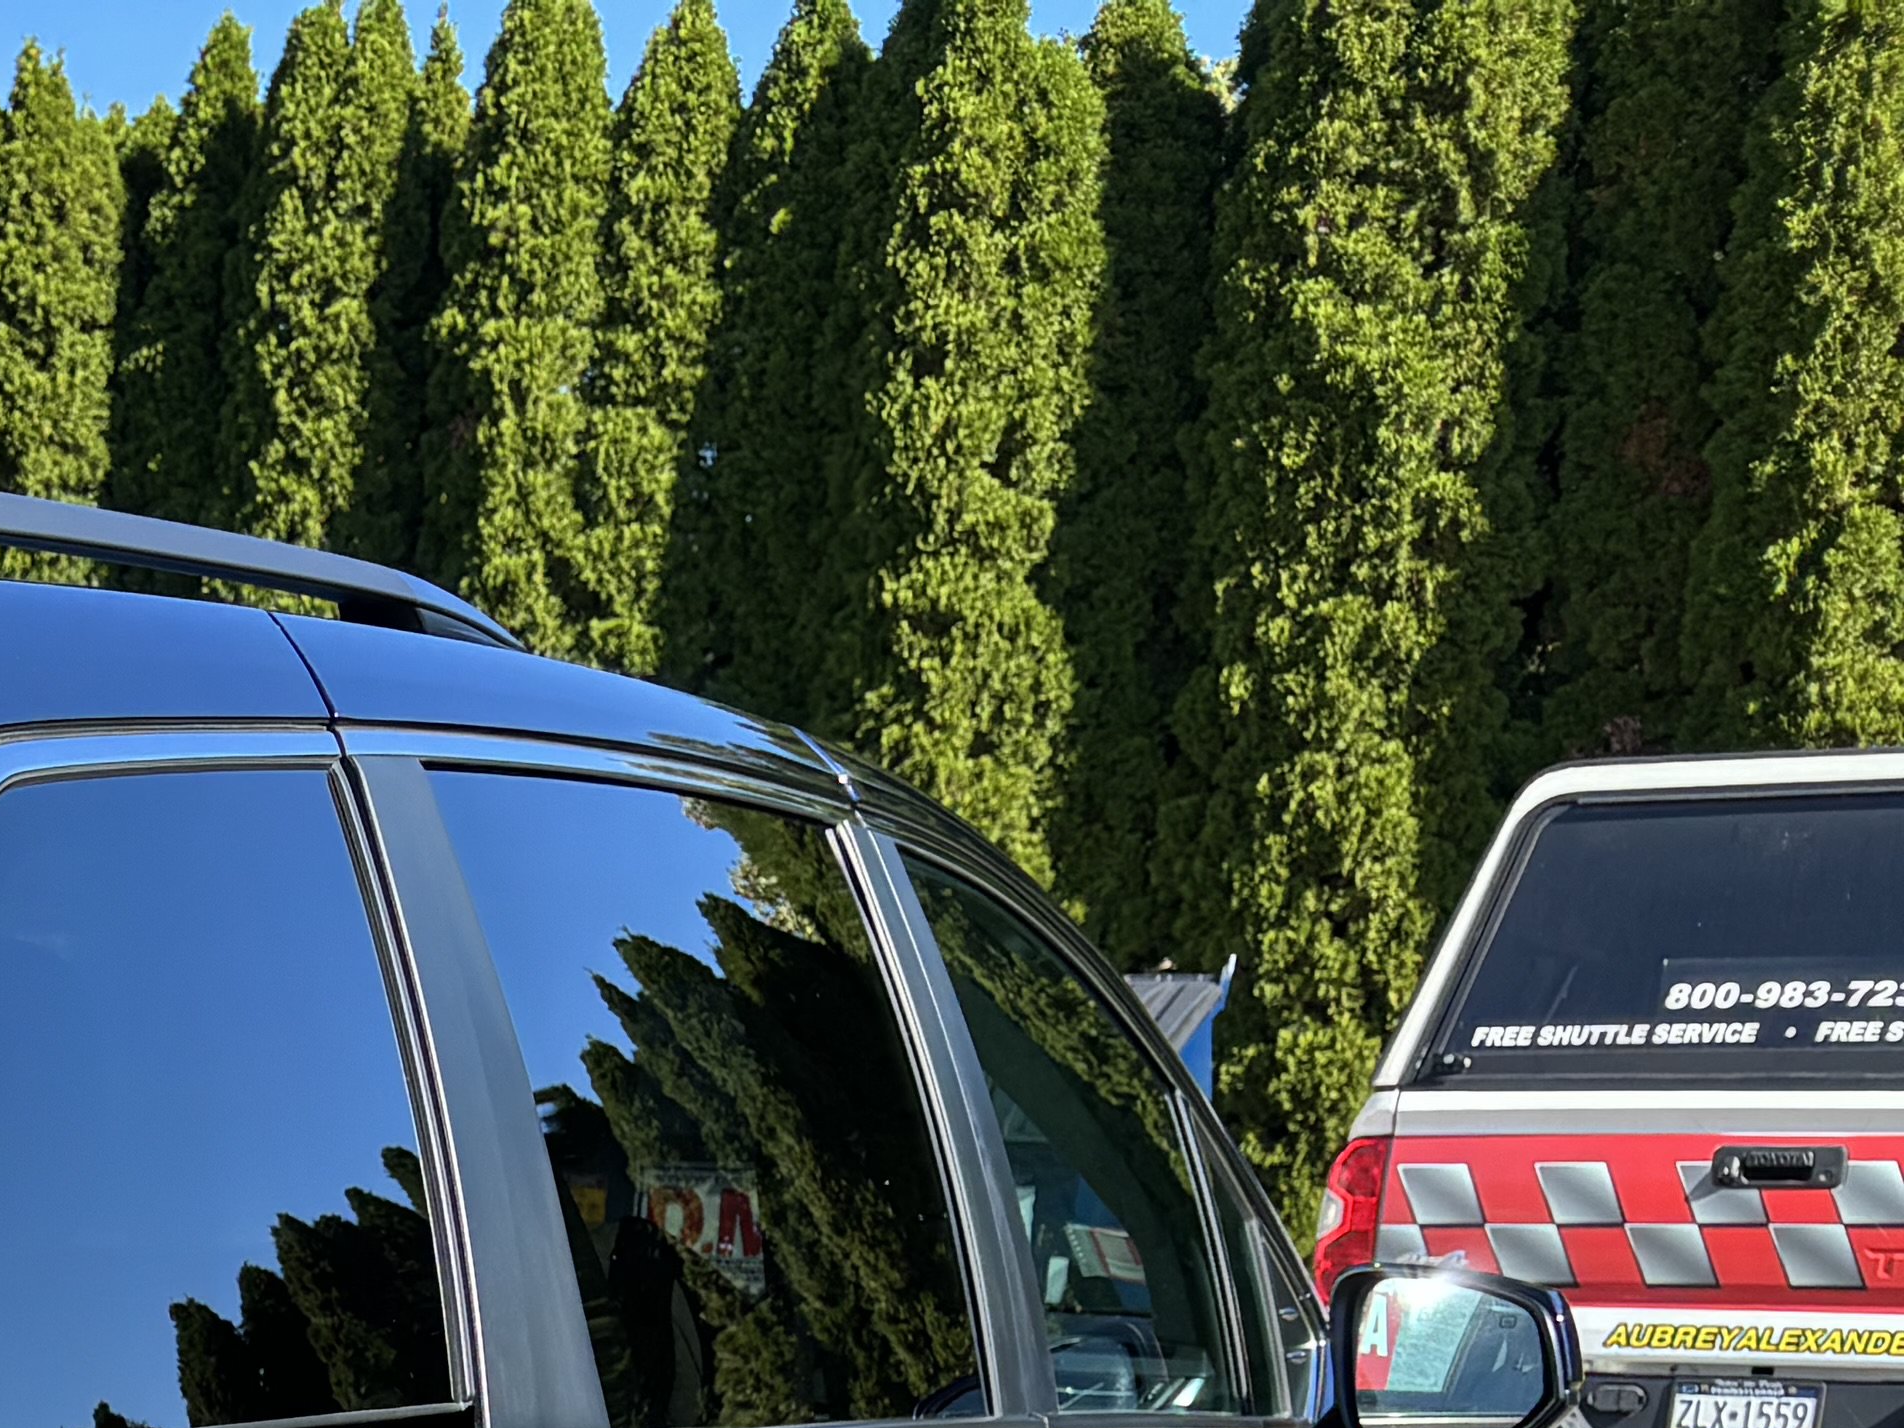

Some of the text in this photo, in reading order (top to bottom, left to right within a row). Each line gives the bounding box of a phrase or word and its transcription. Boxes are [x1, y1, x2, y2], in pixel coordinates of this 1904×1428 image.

[1471, 1025, 1533, 1047] FREE
[1536, 1023, 1647, 1047] SHUTTLE
[1651, 1022, 1761, 1046] SERVICE
[1814, 1020, 1884, 1043] FREE
[1604, 1322, 1904, 1356] AUBREYALEXANDE
